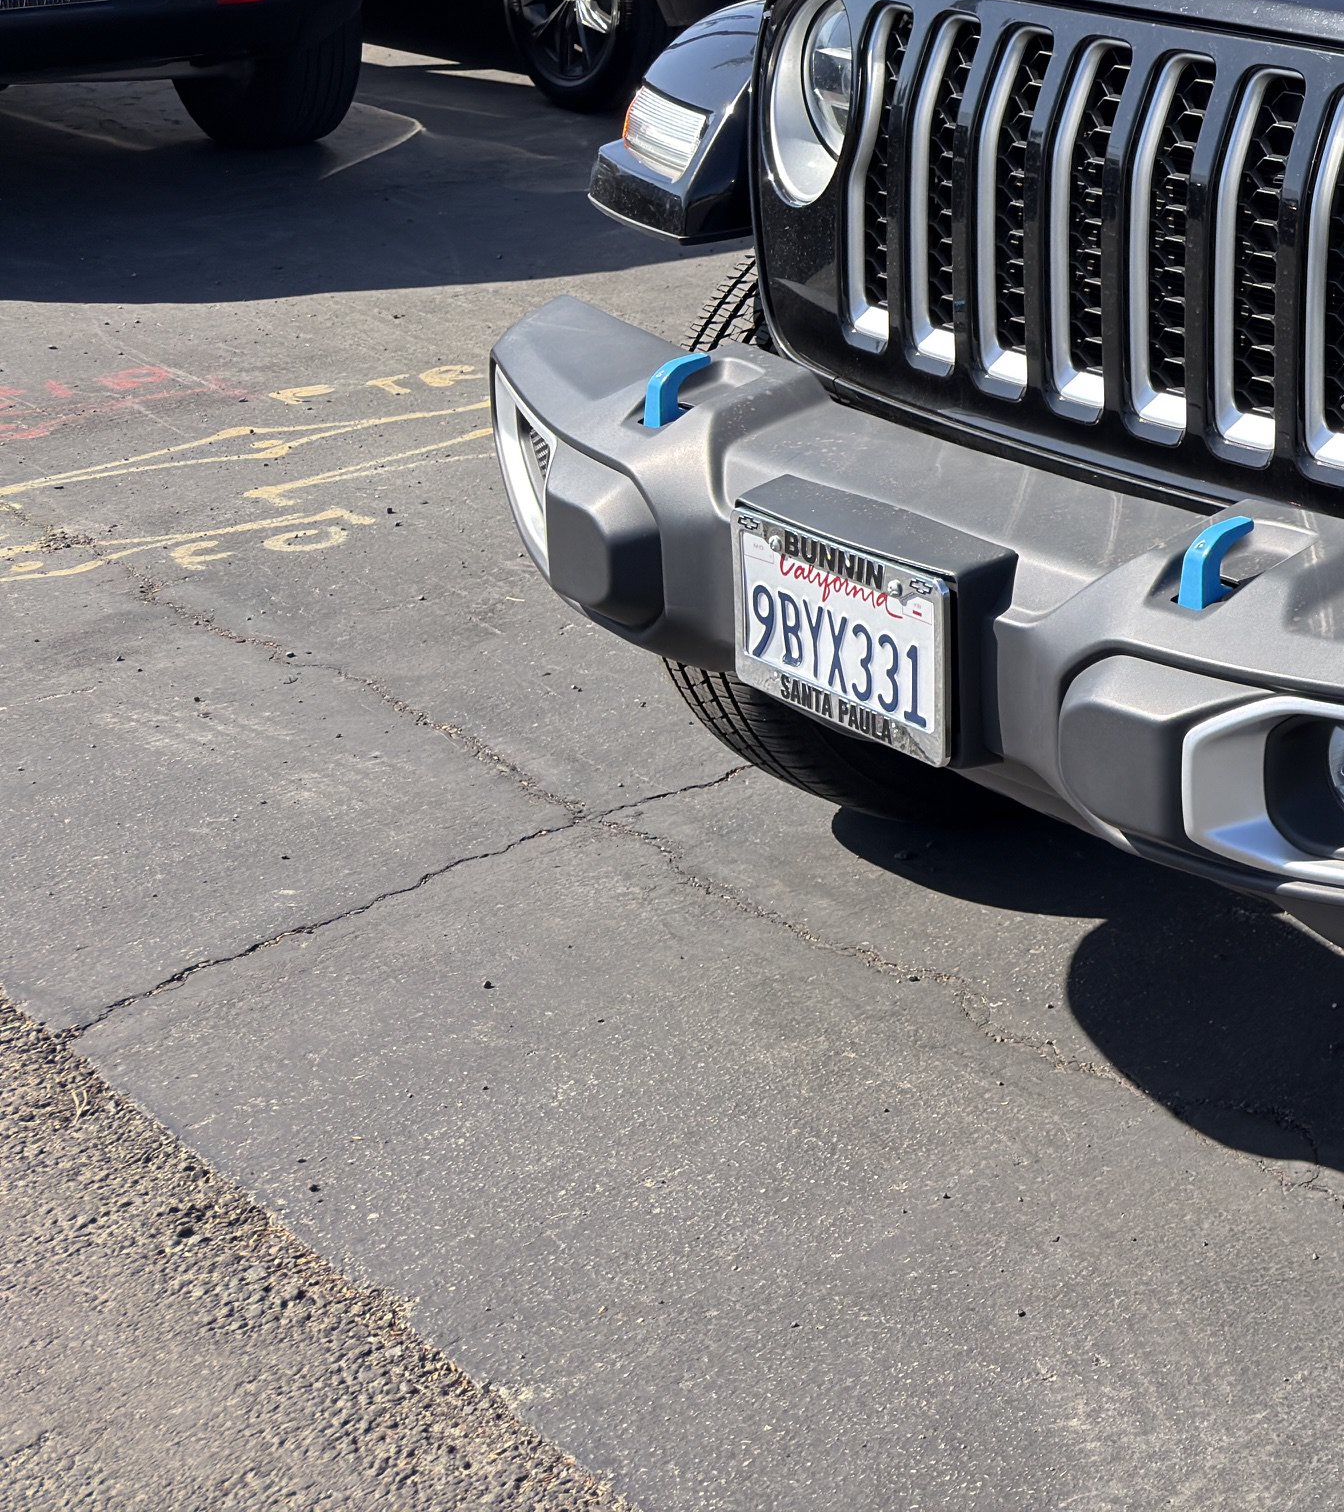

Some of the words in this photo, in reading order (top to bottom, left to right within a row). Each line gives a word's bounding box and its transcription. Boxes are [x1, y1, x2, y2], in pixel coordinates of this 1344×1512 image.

[779, 553, 903, 619] California
[784, 529, 885, 590] BUNNIN
[752, 584, 927, 728] 9BYX331
[780, 673, 833, 719] SANTA
[838, 702, 893, 744] PAULA
